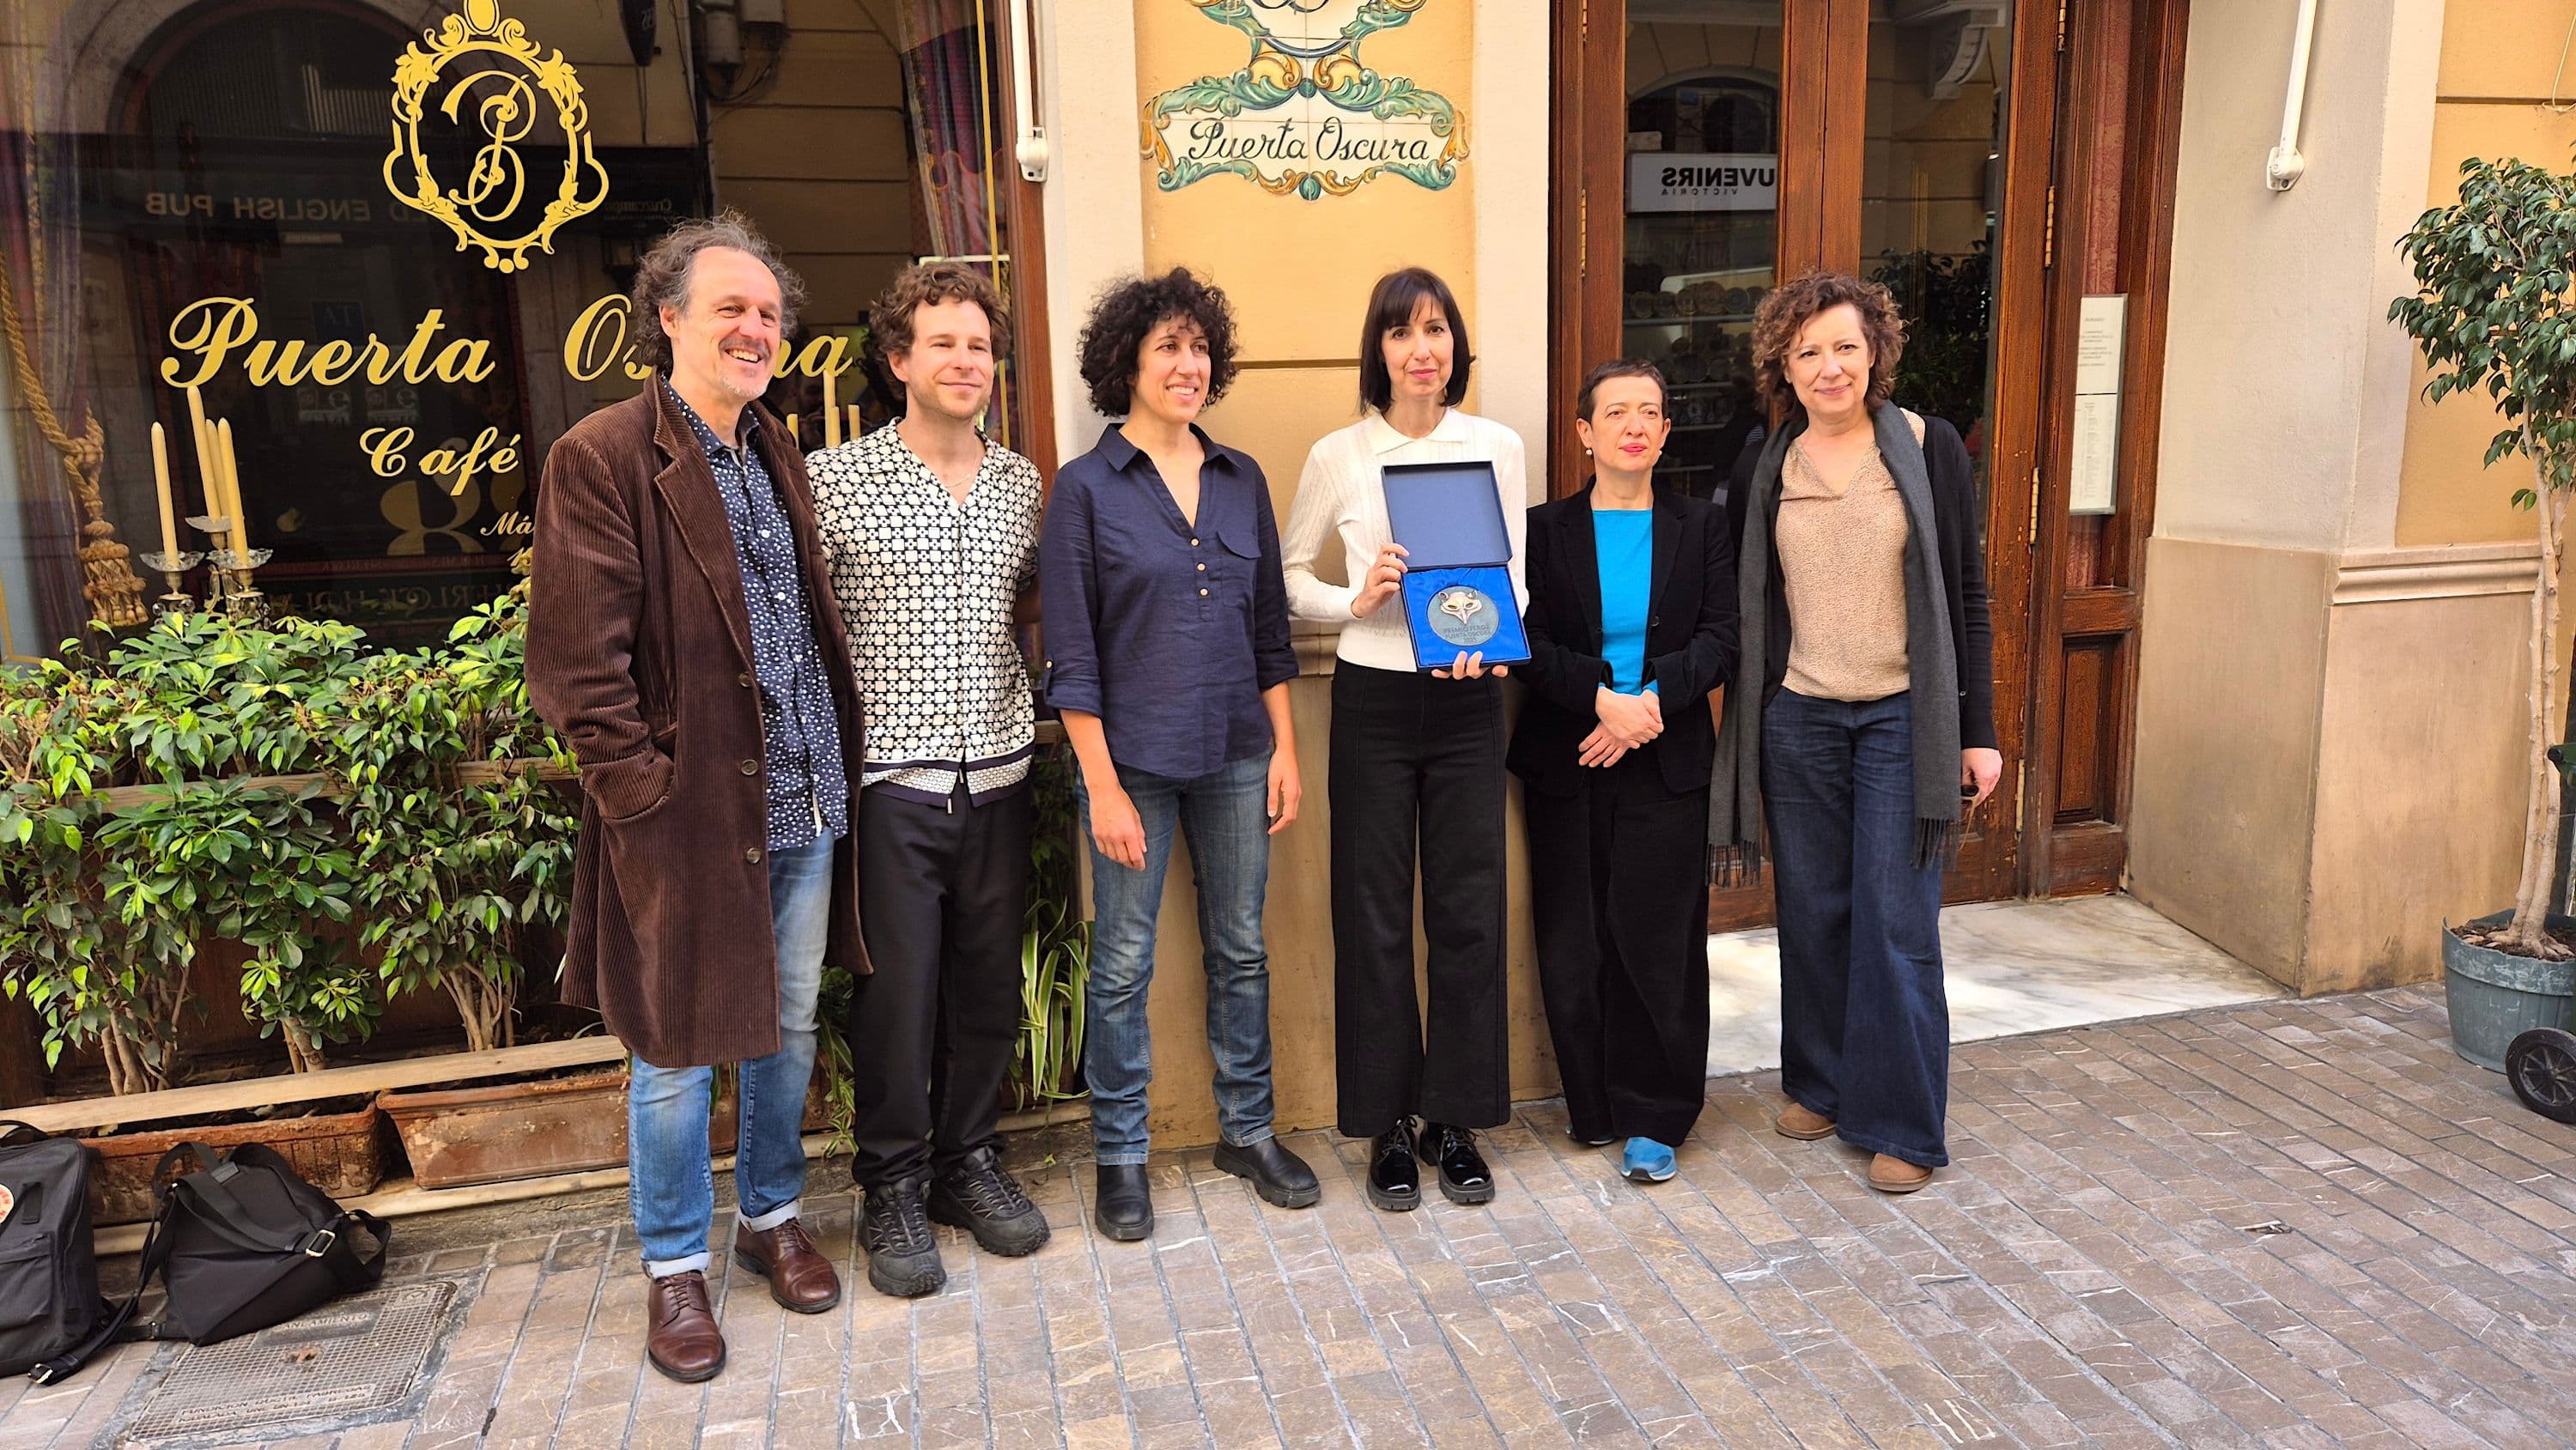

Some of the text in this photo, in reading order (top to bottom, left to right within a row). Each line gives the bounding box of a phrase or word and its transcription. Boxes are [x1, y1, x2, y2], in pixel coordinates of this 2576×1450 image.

[1188, 116, 1431, 161] Puerta Oscura
[161, 296, 495, 388] Puerta
[359, 426, 520, 496] Café
